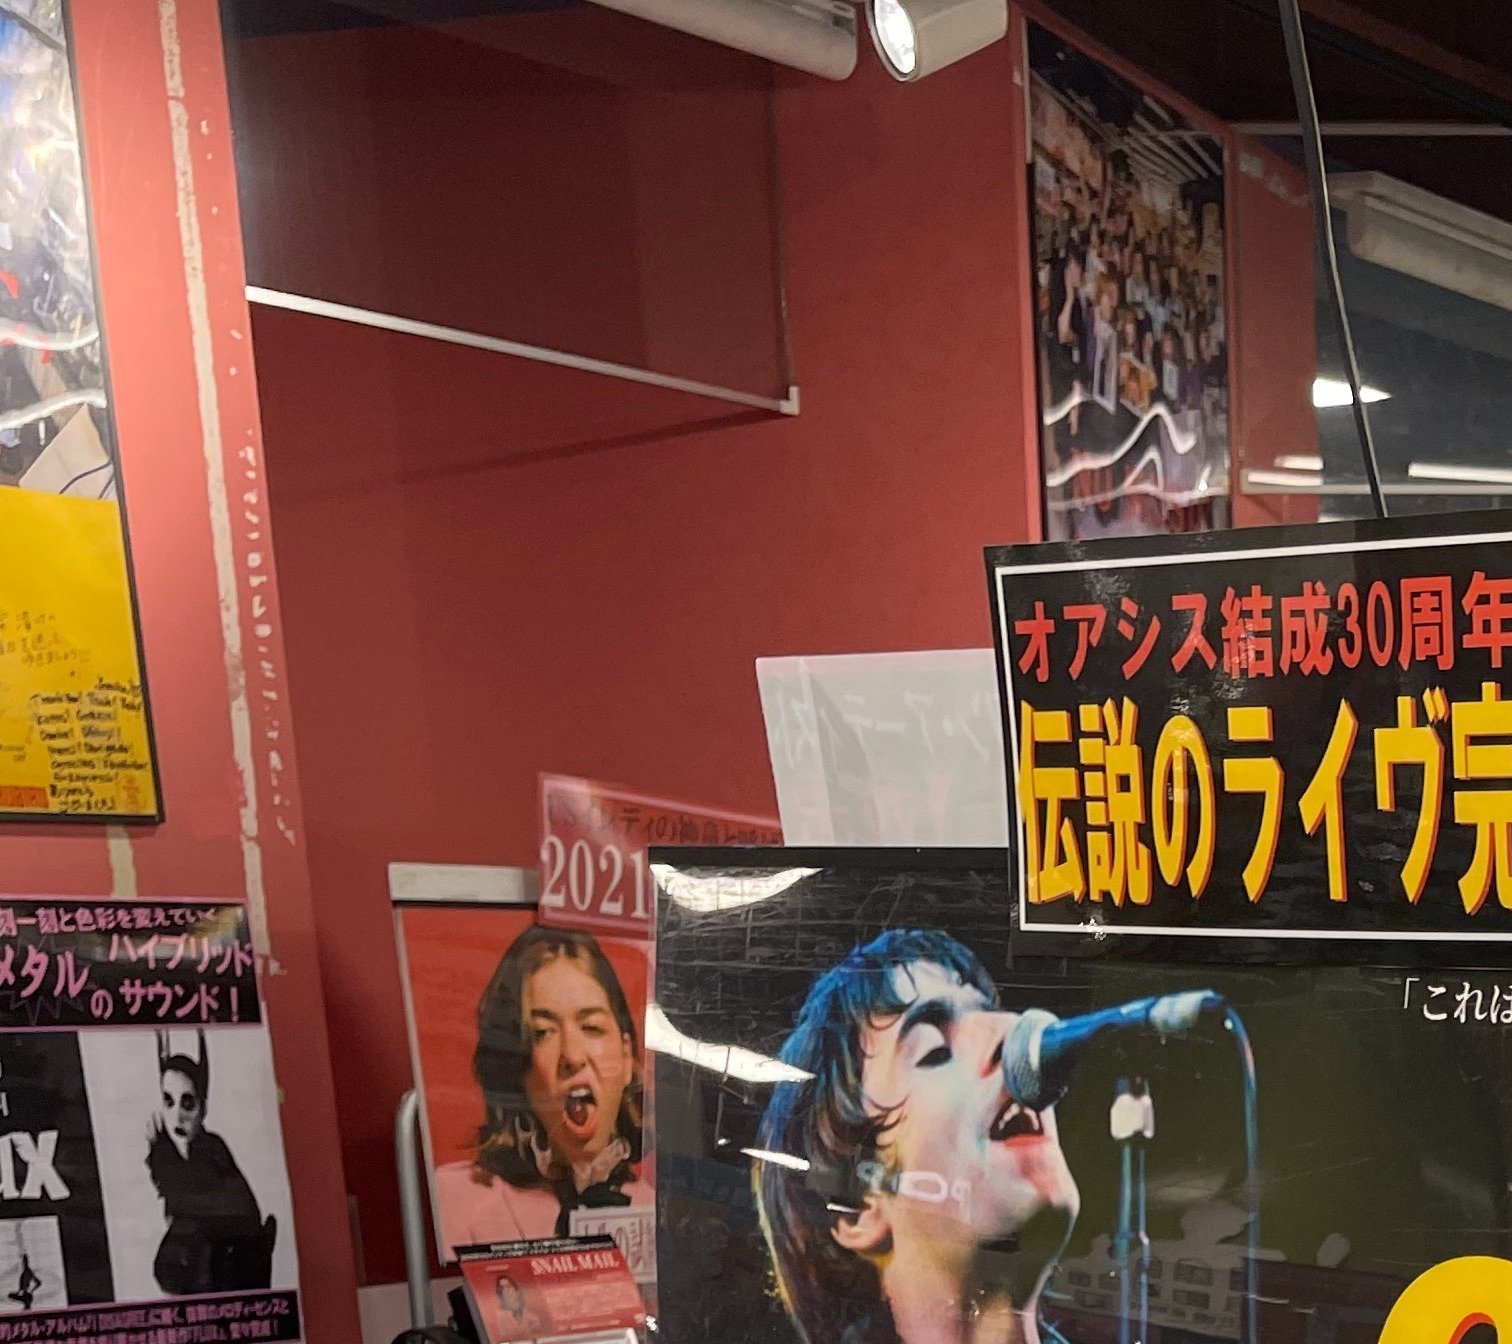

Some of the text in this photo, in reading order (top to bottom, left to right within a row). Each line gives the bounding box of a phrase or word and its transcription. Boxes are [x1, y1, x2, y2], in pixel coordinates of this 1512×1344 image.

[541, 836, 649, 918] 2021
[109, 934, 253, 978] ハイブリッド
